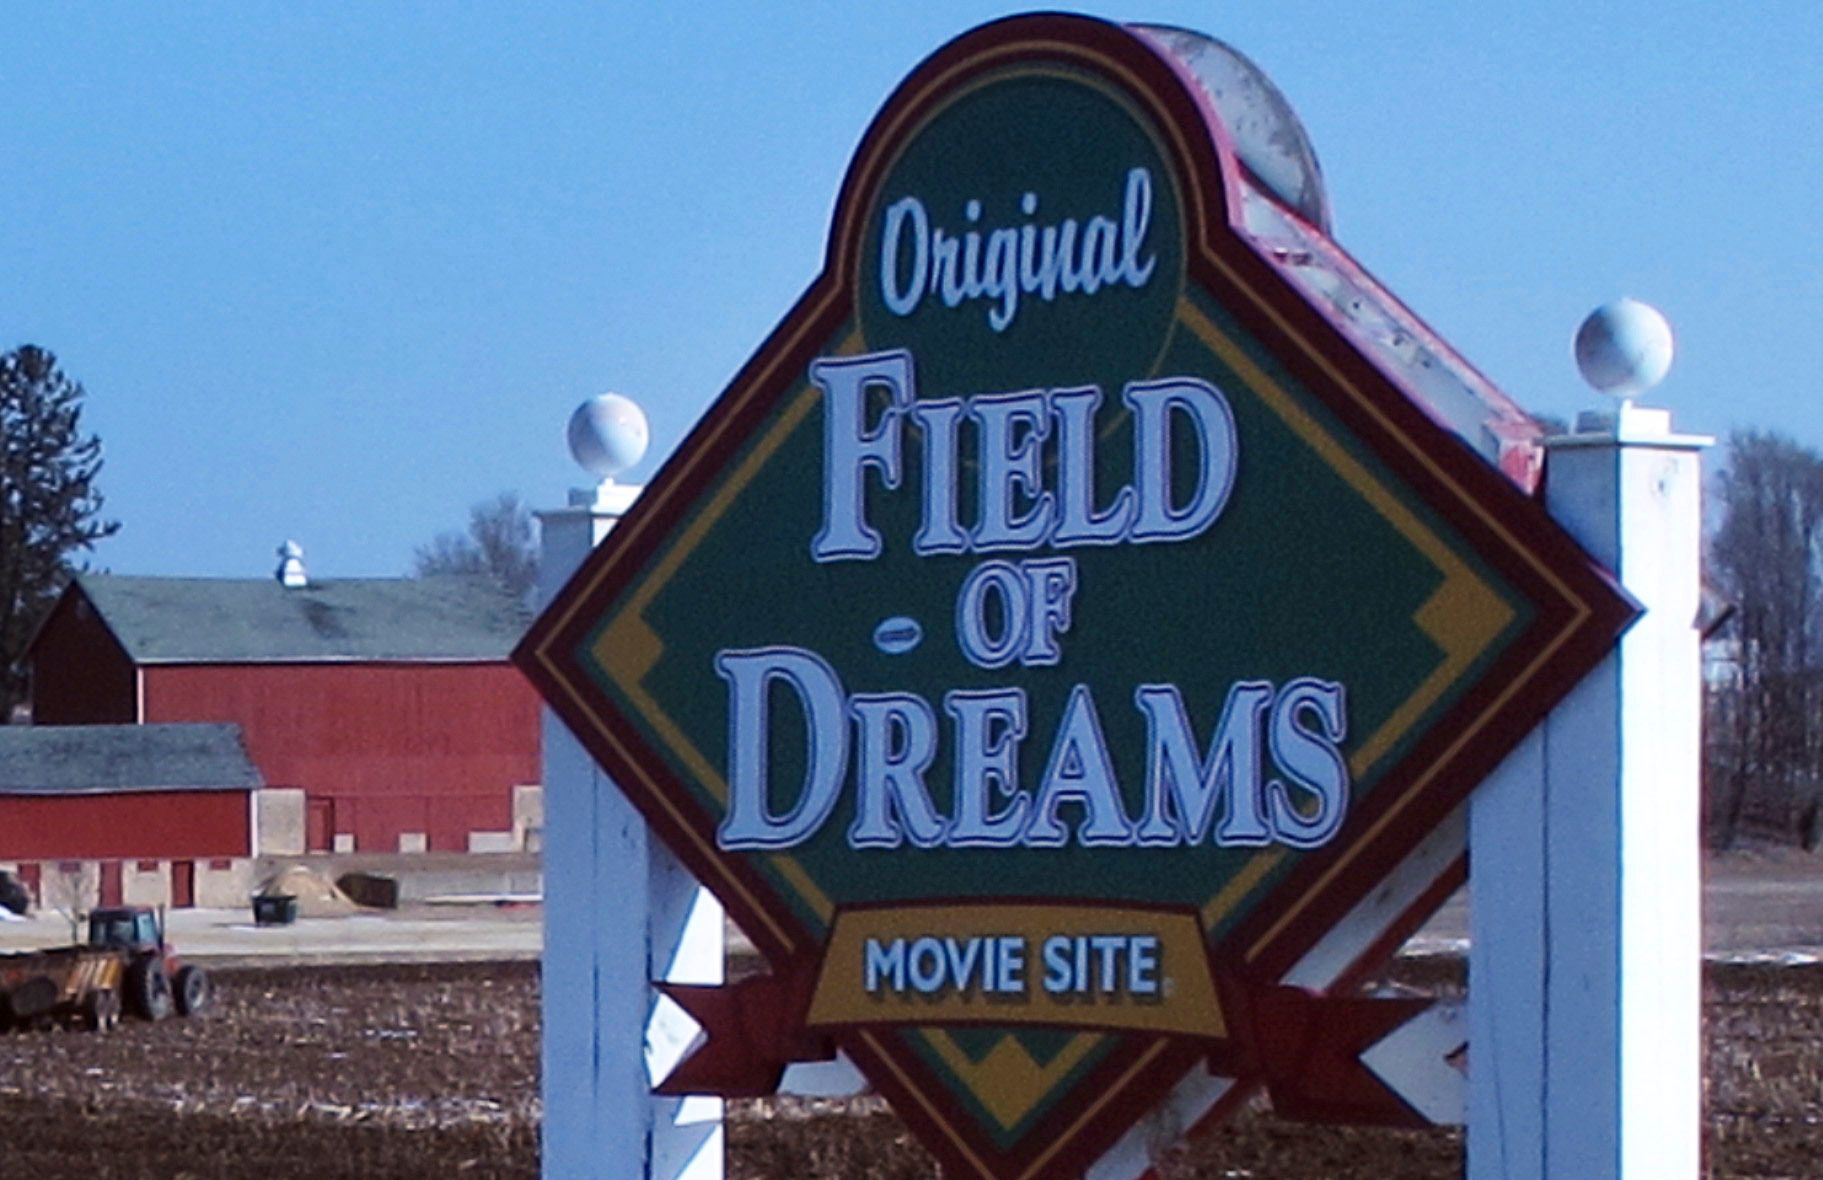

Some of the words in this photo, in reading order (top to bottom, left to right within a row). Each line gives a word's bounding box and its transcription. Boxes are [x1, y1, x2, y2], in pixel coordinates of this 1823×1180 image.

[880, 167, 1156, 331] Original
[809, 348, 1239, 563] FIELD
[955, 557, 1075, 669] OF
[714, 647, 1350, 849] DREAMS
[864, 934, 1029, 994] MOVIE
[1042, 934, 1160, 993] SITE
